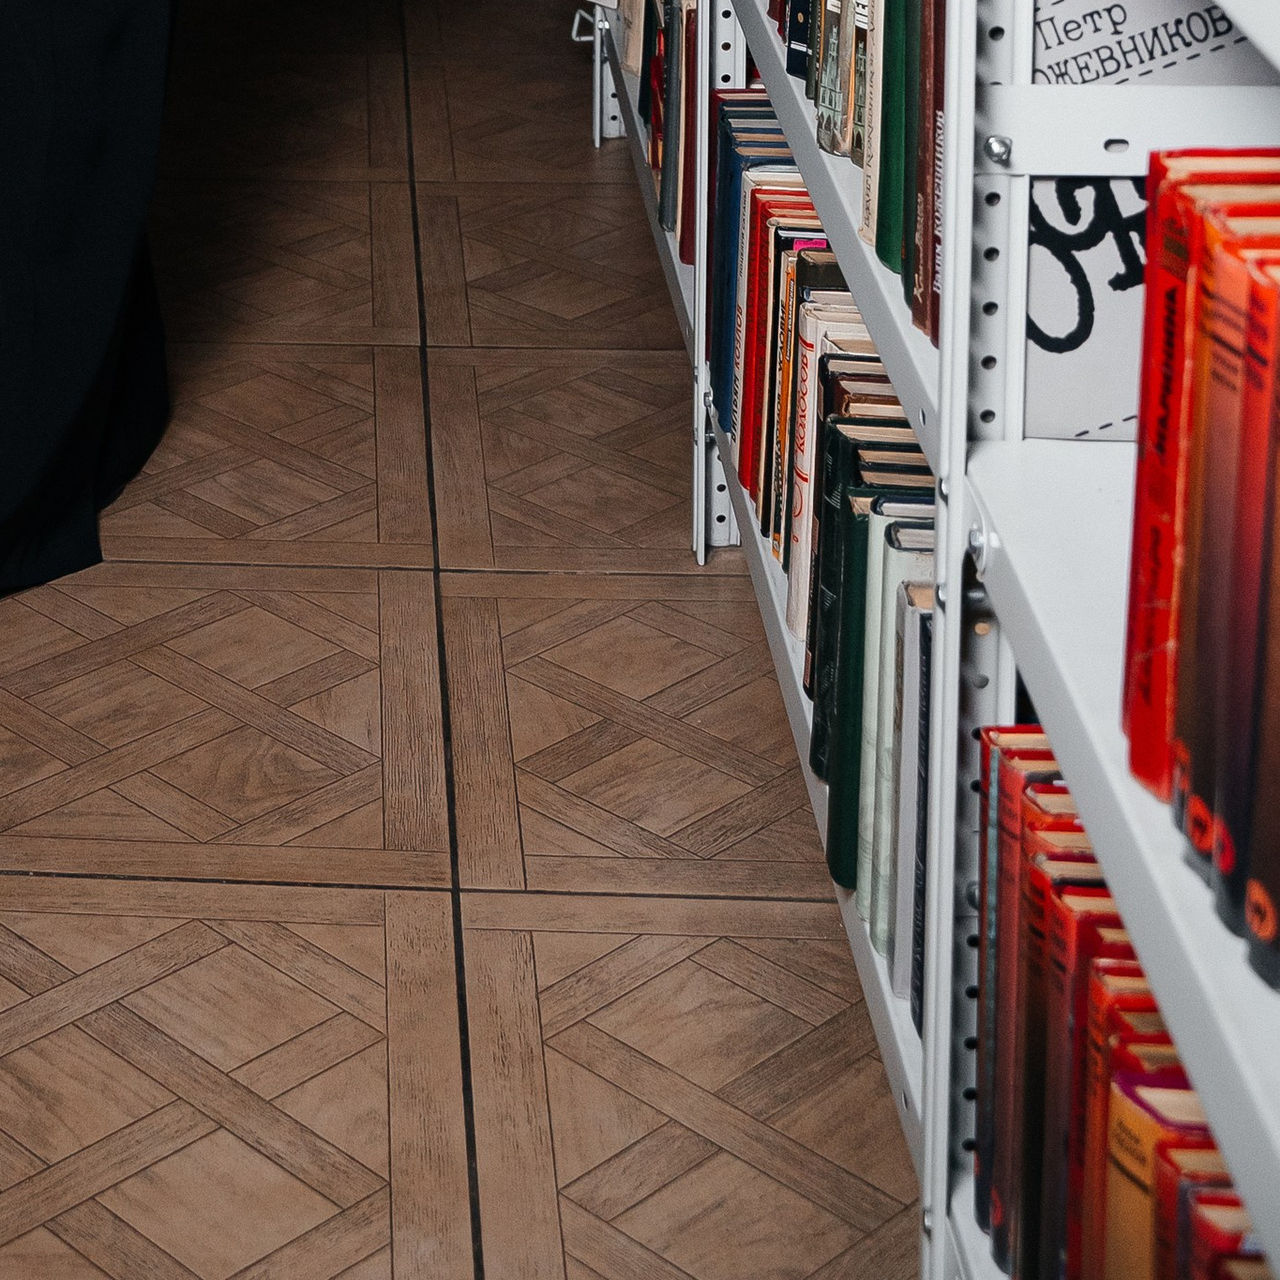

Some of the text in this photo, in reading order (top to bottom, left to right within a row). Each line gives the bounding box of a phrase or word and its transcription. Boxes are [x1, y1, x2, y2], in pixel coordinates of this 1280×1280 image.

[1036, 3, 1127, 50] Петр
[730, 304, 744, 444] ВИЛЬЯМ КОЗЛОВ
[797, 353, 810, 456] КОЛОСОВ
